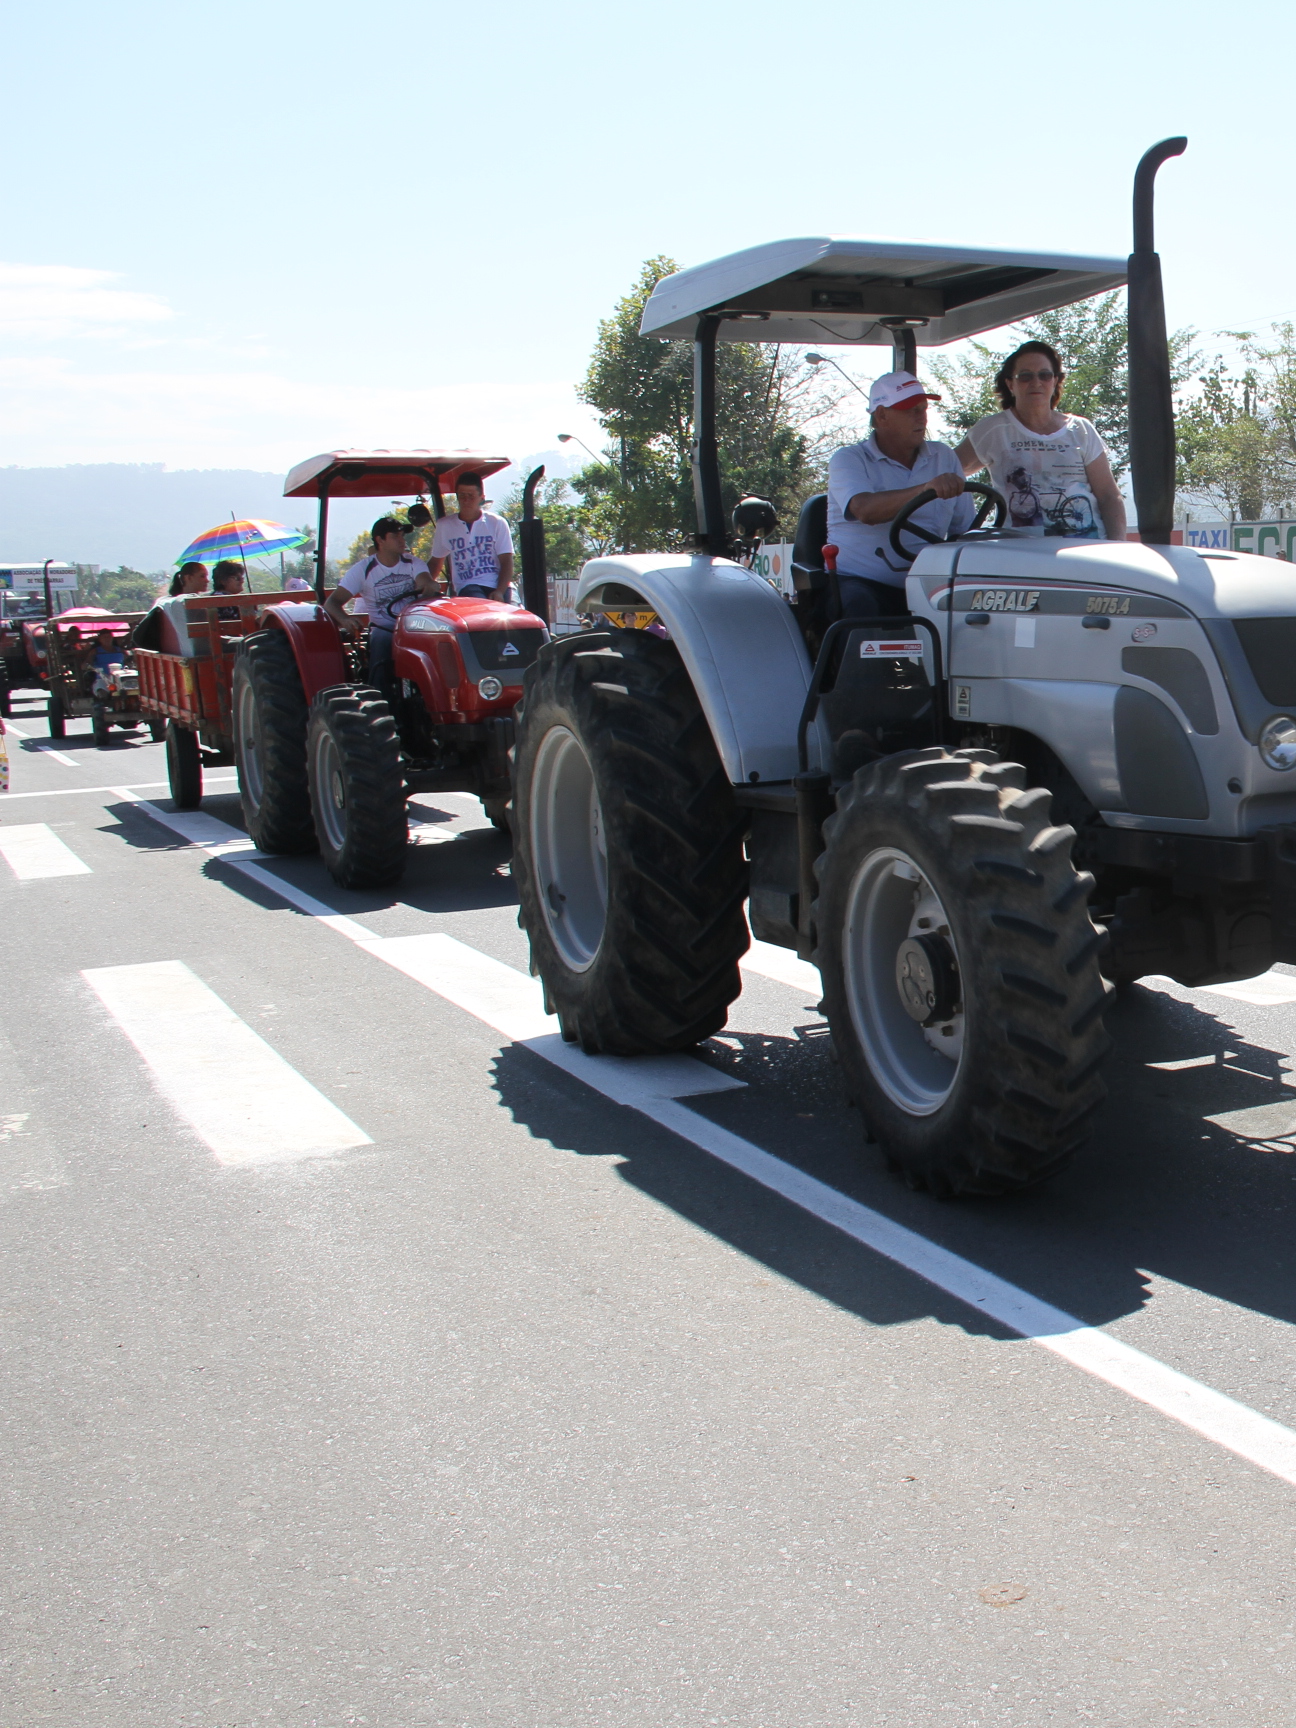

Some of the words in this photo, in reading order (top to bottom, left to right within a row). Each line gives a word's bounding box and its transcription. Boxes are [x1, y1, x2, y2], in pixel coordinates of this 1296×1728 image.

[1188, 529, 1227, 548] TAXI
[971, 590, 1041, 612] AGRALE
[1086, 596, 1131, 615] 5075.4
